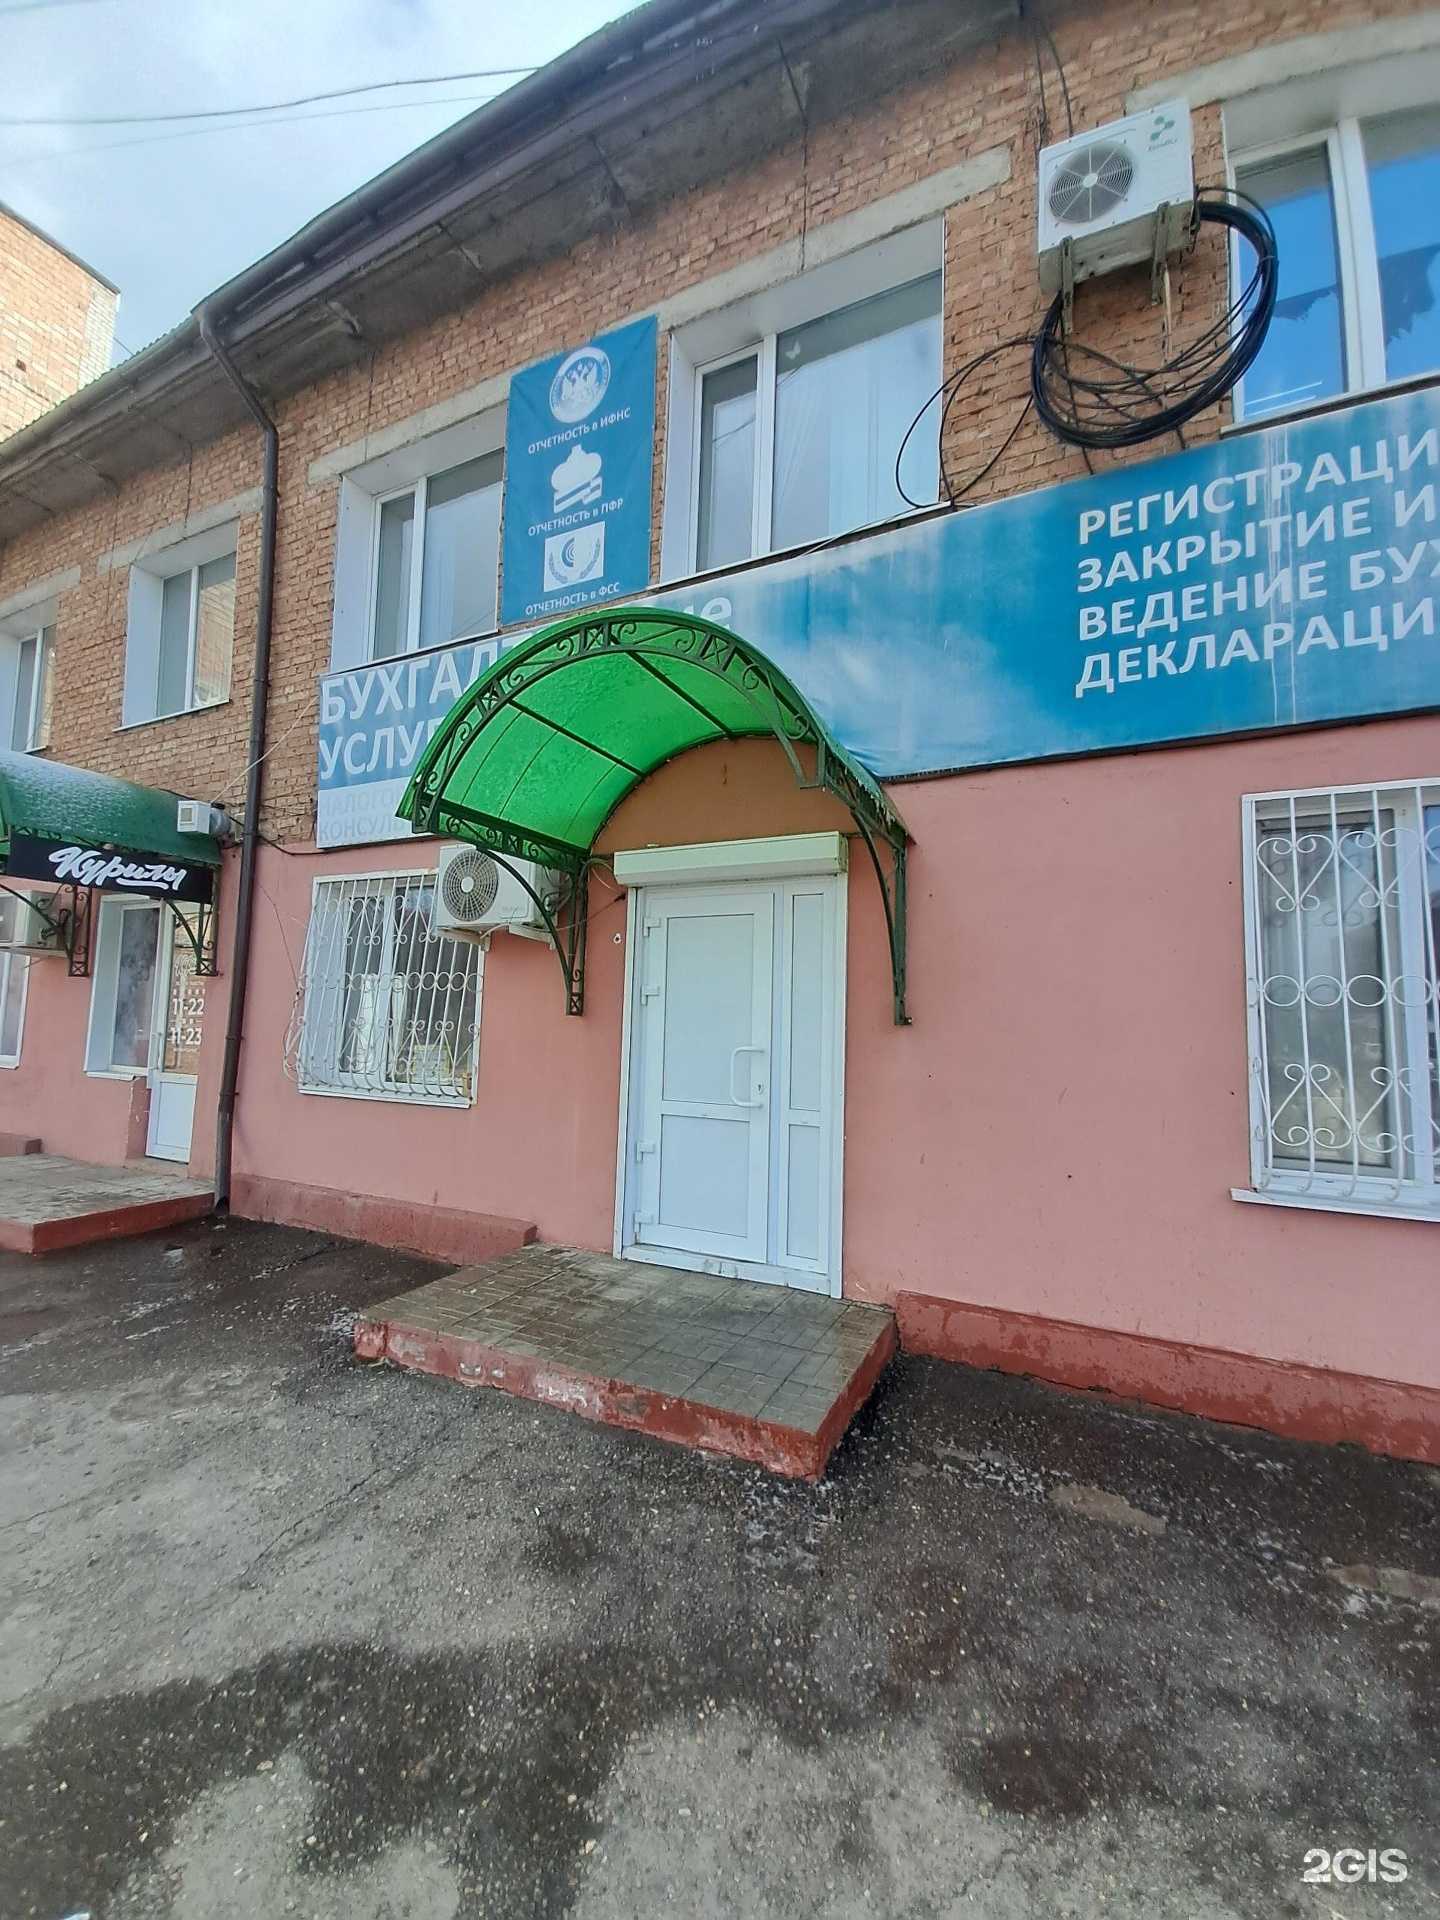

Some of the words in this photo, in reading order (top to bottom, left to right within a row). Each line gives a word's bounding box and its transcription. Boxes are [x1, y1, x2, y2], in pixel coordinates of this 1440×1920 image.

[528, 425, 590, 455] ОТЧЕТНОСТЬ
[600, 407, 631, 429] ИФНС
[527, 507, 590, 537] ОТЧЕТНОСТЬ
[600, 498, 624, 517] ПФР
[1078, 428, 1438, 545] РЕГИСТРАЦИ
[1077, 497, 1372, 593] ЗАКРЫТИЕ
[1394, 484, 1436, 528] И
[525, 591, 588, 616] ОТЧЕТНОСТЬ
[598, 582, 621, 598] ФСС
[1079, 560, 1327, 641] ВЕДЕНИЕ
[1074, 597, 1435, 699] ДЕКЛАРАЦИ
